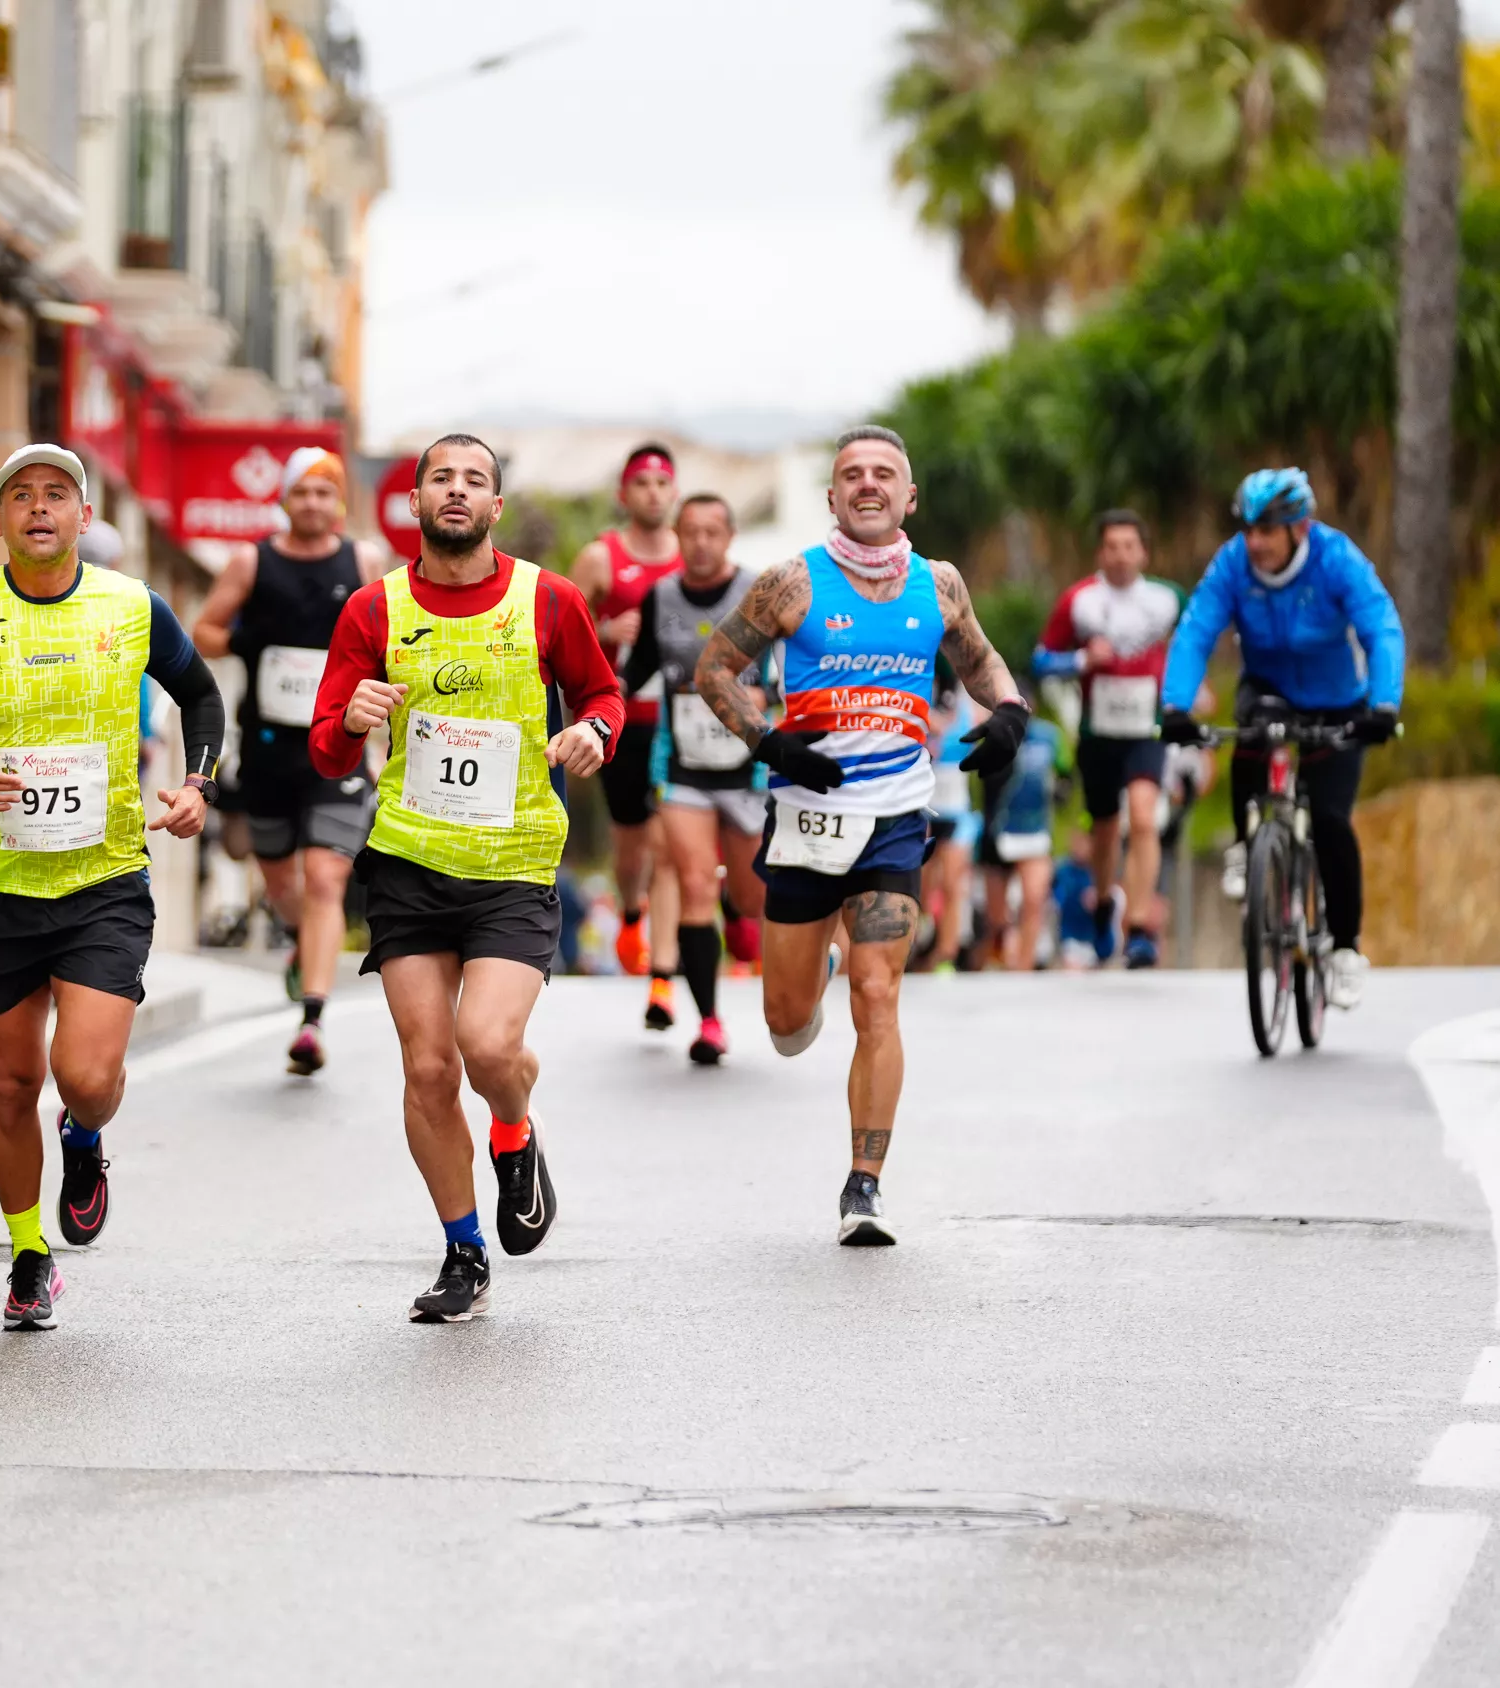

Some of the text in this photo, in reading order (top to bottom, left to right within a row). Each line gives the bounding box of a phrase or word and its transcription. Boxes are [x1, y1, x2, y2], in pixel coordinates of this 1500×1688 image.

[819, 653, 927, 676] enerplus
[831, 689, 914, 712] Maratón
[836, 713, 904, 733] Lucena
[447, 735, 484, 749] LUCENA
[36, 766, 68, 776] LUCENA
[440, 757, 479, 787] 10
[21, 786, 81, 815] 975
[798, 809, 844, 839] 631
